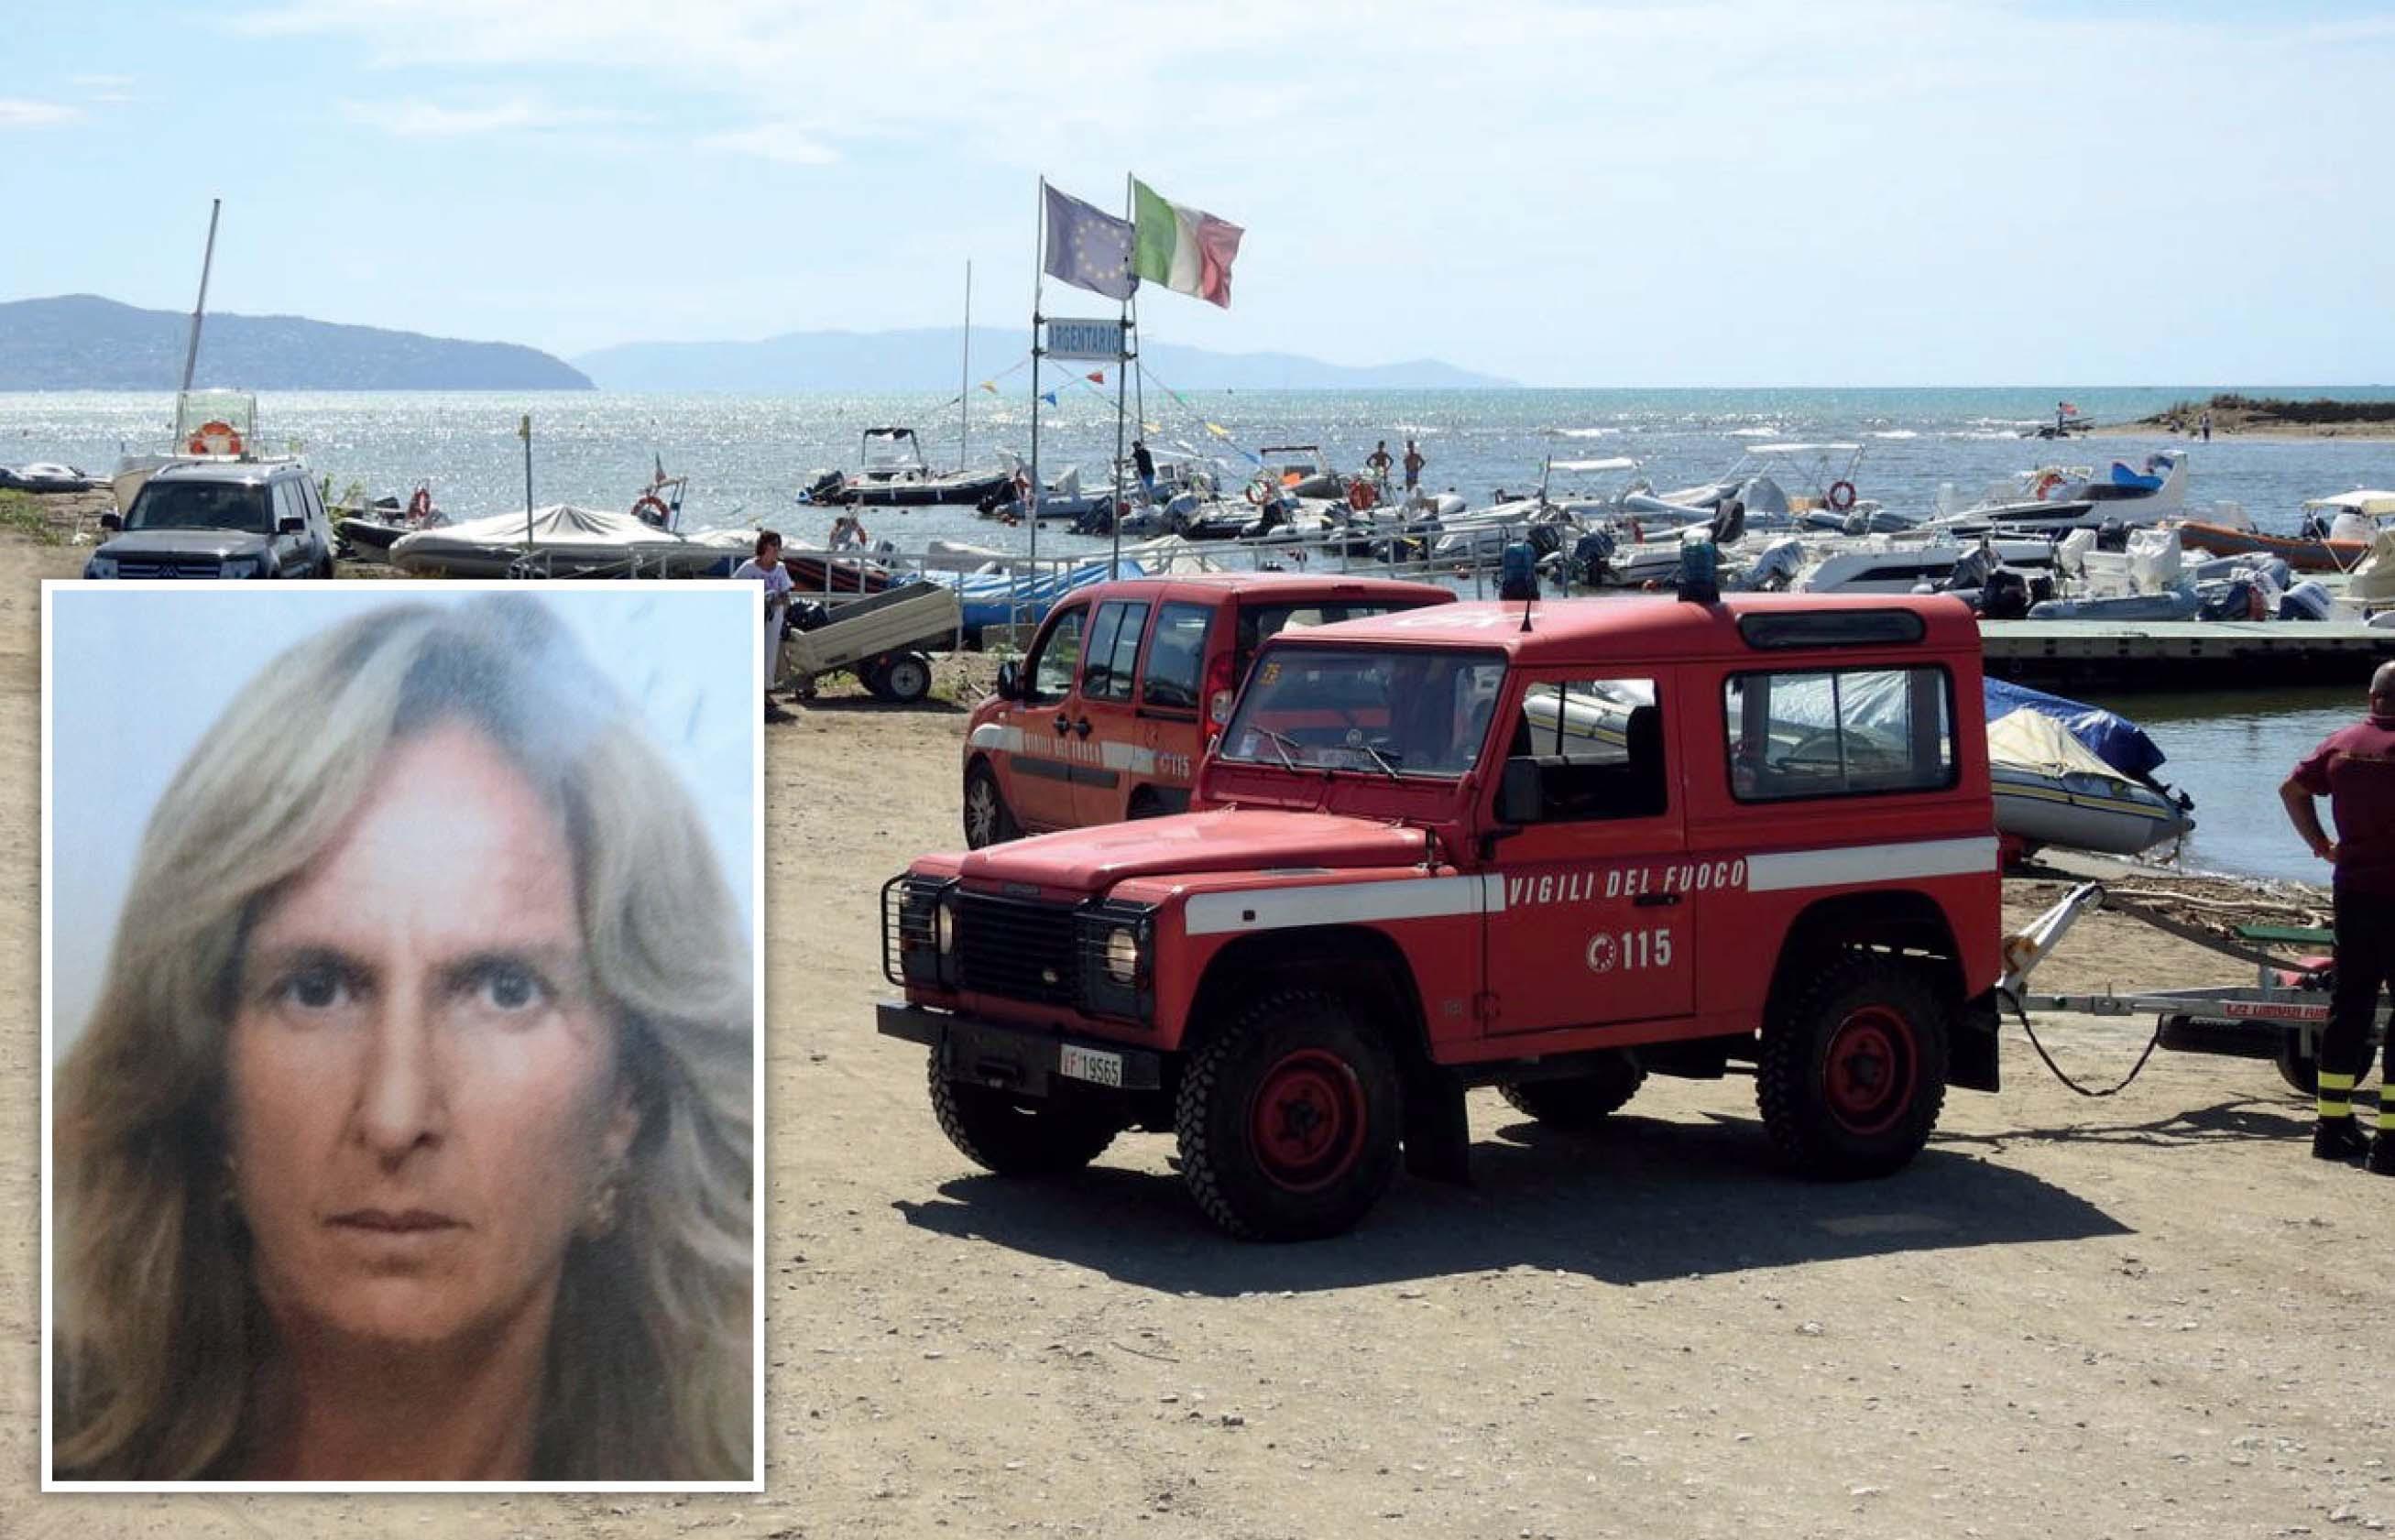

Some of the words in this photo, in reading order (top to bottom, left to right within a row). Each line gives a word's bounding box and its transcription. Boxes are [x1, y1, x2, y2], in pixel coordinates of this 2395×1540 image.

[1048, 324, 1121, 353] ARGENTARIO
[1172, 754, 1190, 777] 115
[1510, 872, 1594, 906] VIGILI
[1606, 868, 1650, 897] DEL
[1664, 860, 1745, 892] FUOCO
[1622, 928, 1672, 970] 115
